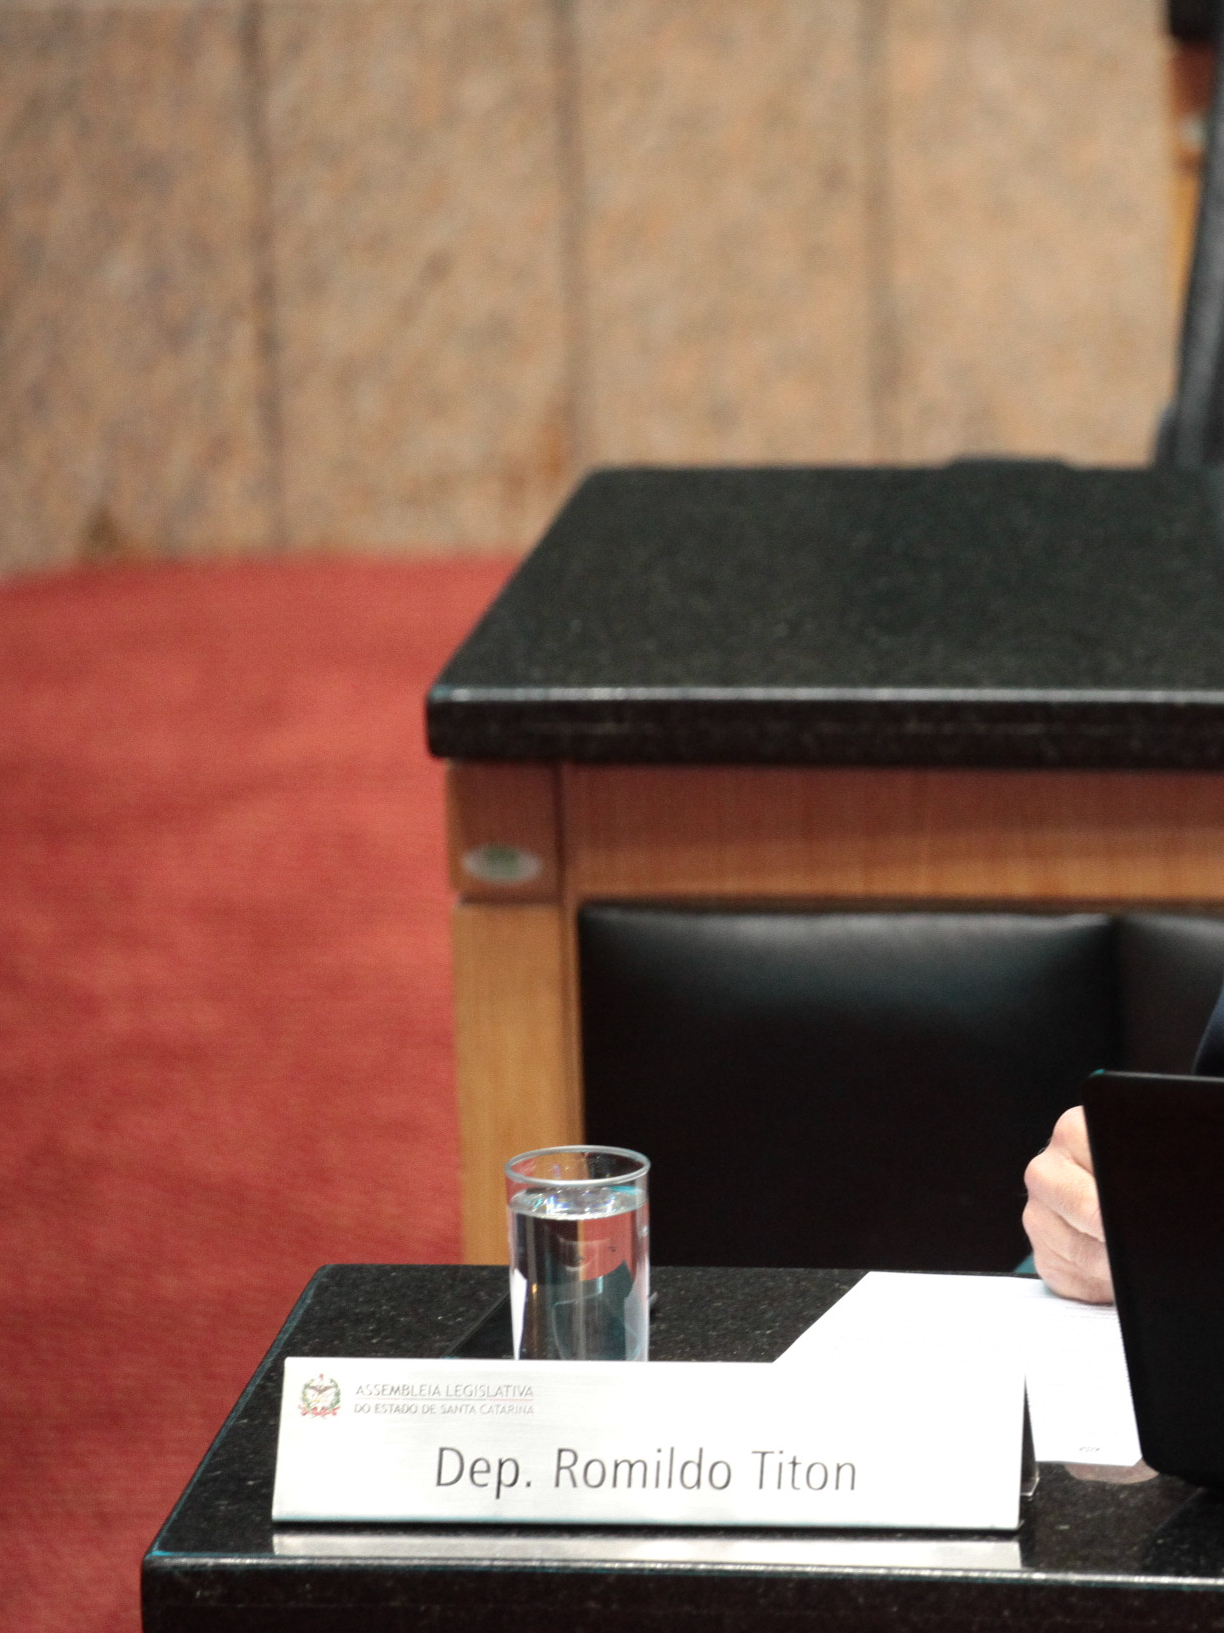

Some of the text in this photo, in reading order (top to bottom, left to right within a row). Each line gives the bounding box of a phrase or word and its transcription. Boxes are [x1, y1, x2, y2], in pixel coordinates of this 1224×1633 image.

[356, 1383, 533, 1397] ASSEMBLEIA LEGISLATIVA
[354, 1403, 533, 1415] DO ESTADO DE SANTA CATARINA
[435, 1446, 856, 1500] Dep. Romildo Titon
